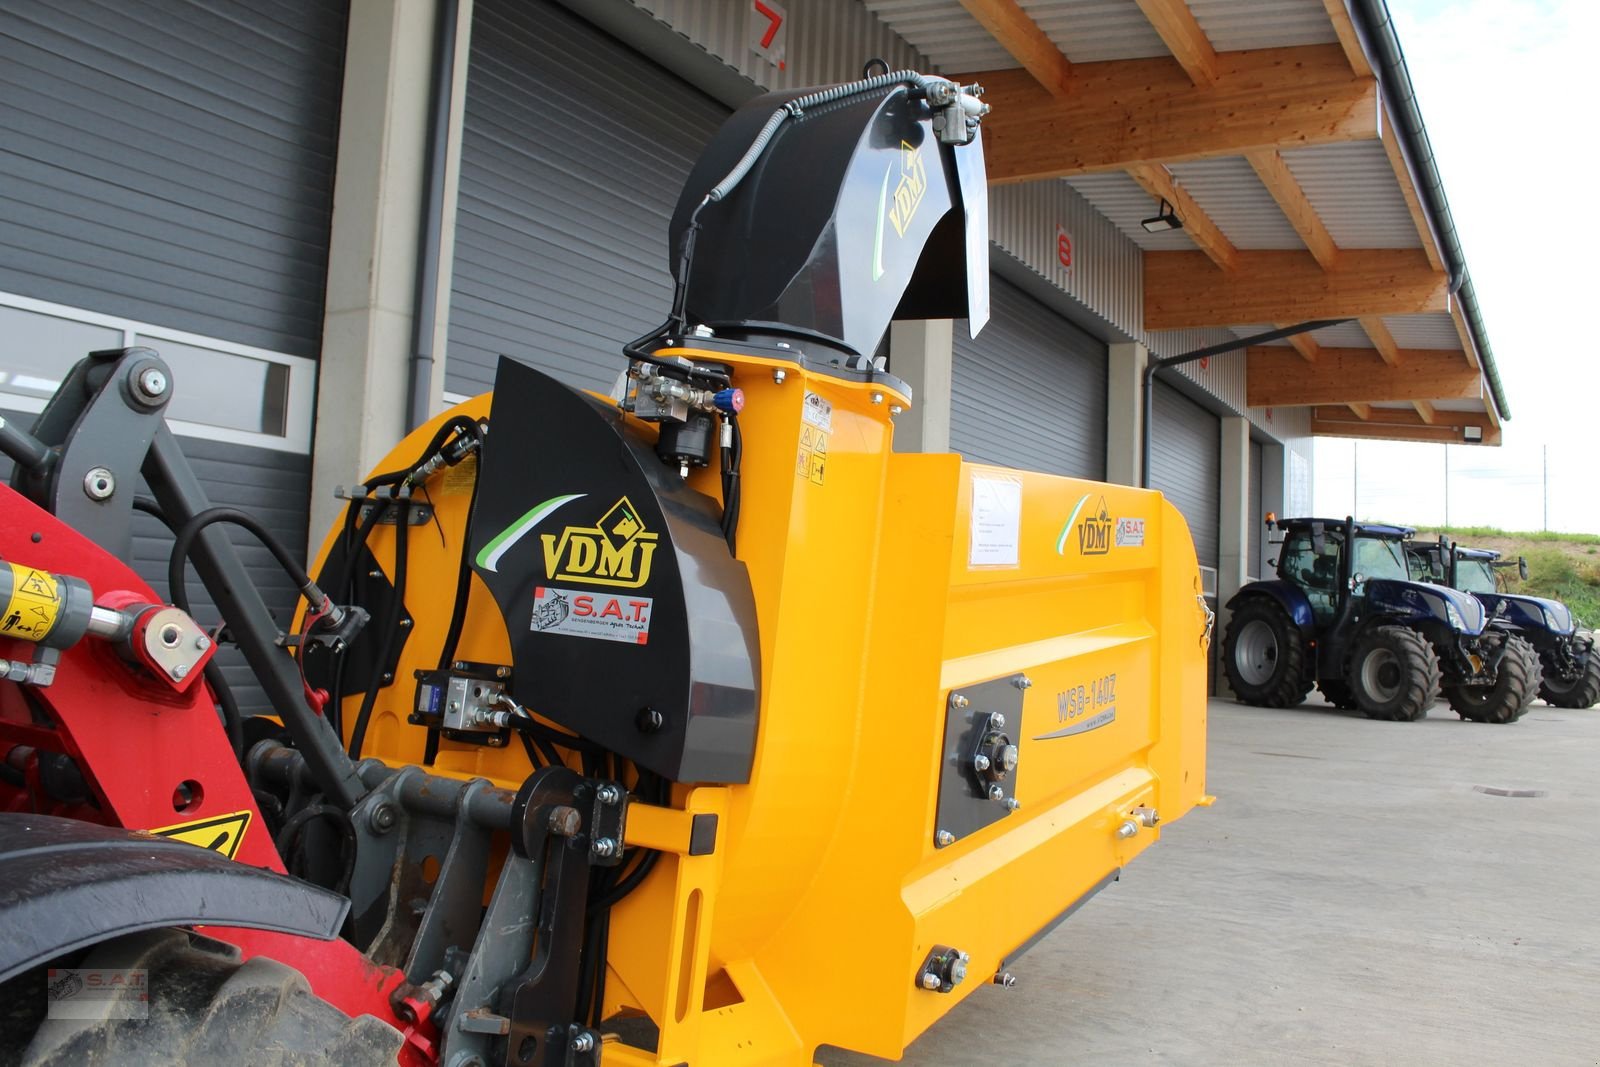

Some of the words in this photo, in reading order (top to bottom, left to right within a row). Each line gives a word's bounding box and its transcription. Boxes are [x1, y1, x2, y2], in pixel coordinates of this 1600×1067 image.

[754, 0, 783, 49] 7
[1058, 234, 1072, 267] 8
[573, 595, 649, 622] S.A.T.
